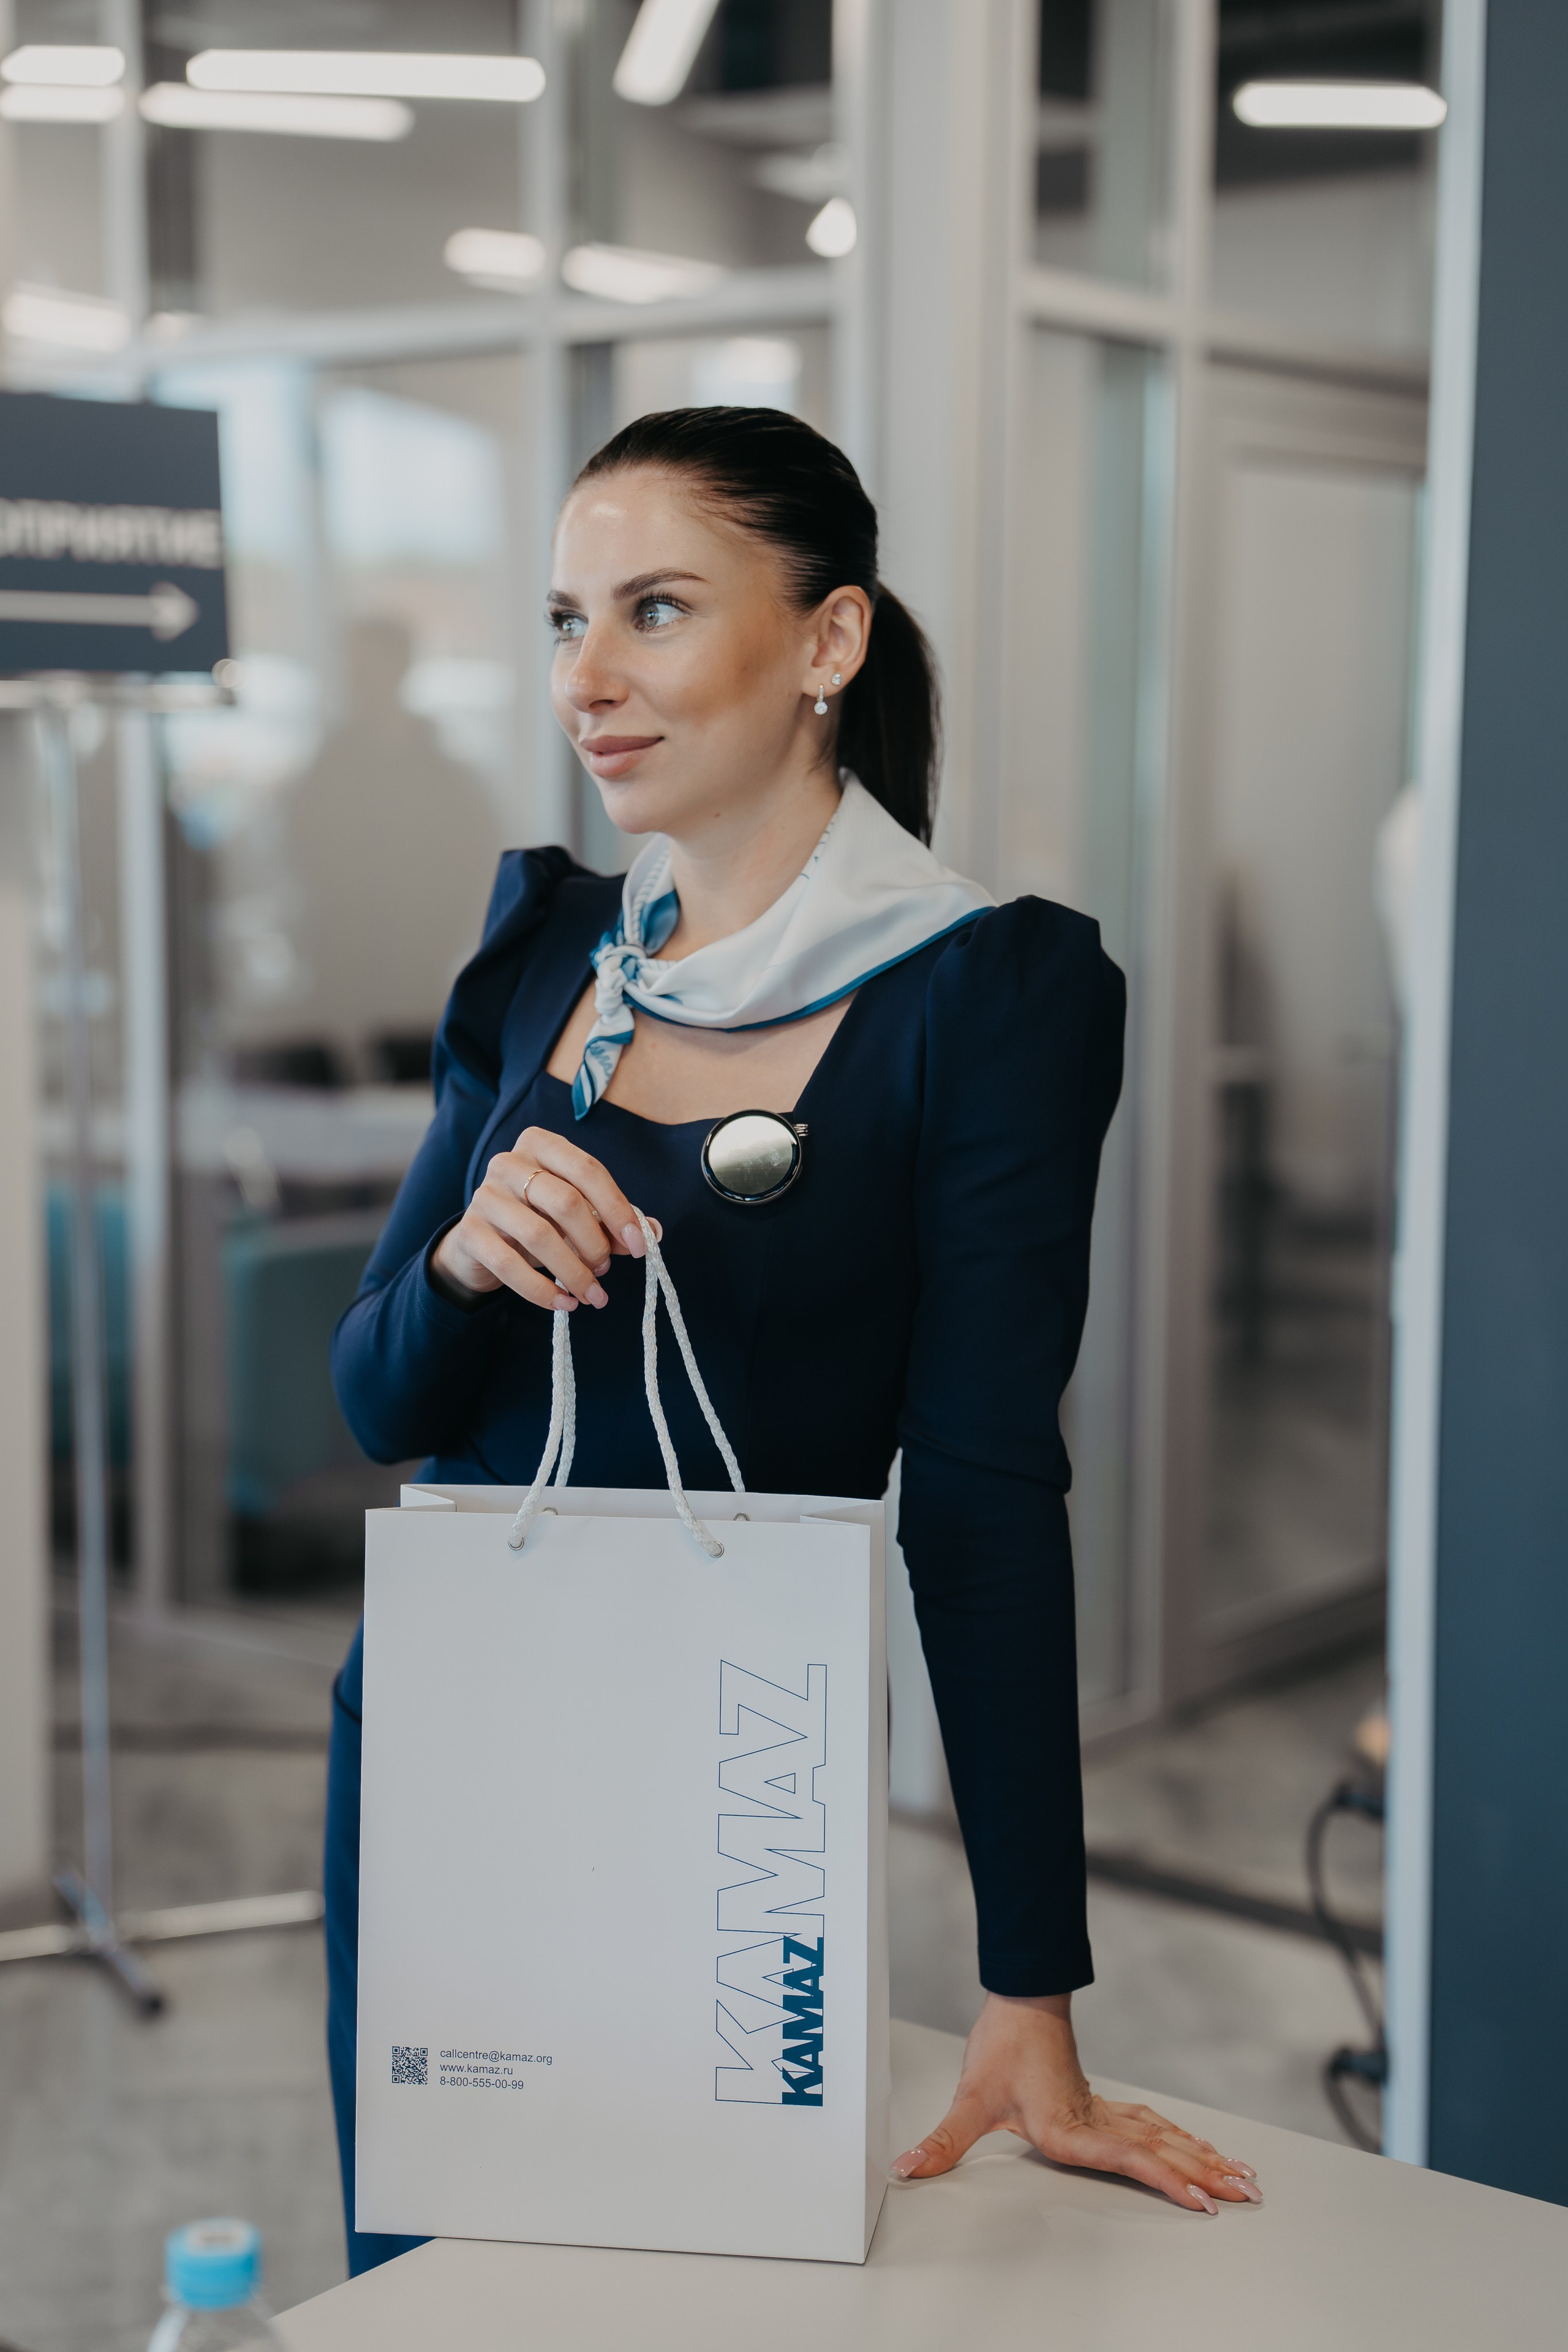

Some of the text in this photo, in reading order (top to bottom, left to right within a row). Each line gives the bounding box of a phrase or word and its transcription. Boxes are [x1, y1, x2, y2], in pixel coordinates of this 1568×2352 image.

[715, 1659, 827, 2108] KAMAZ
[782, 1935, 824, 2107] KAMAZ
[440, 2049, 552, 2065] callcentre@kamaz.org
[440, 2064, 513, 2075] www.kamaz.ru
[440, 2076, 524, 2090] 8-800-555-00-99
